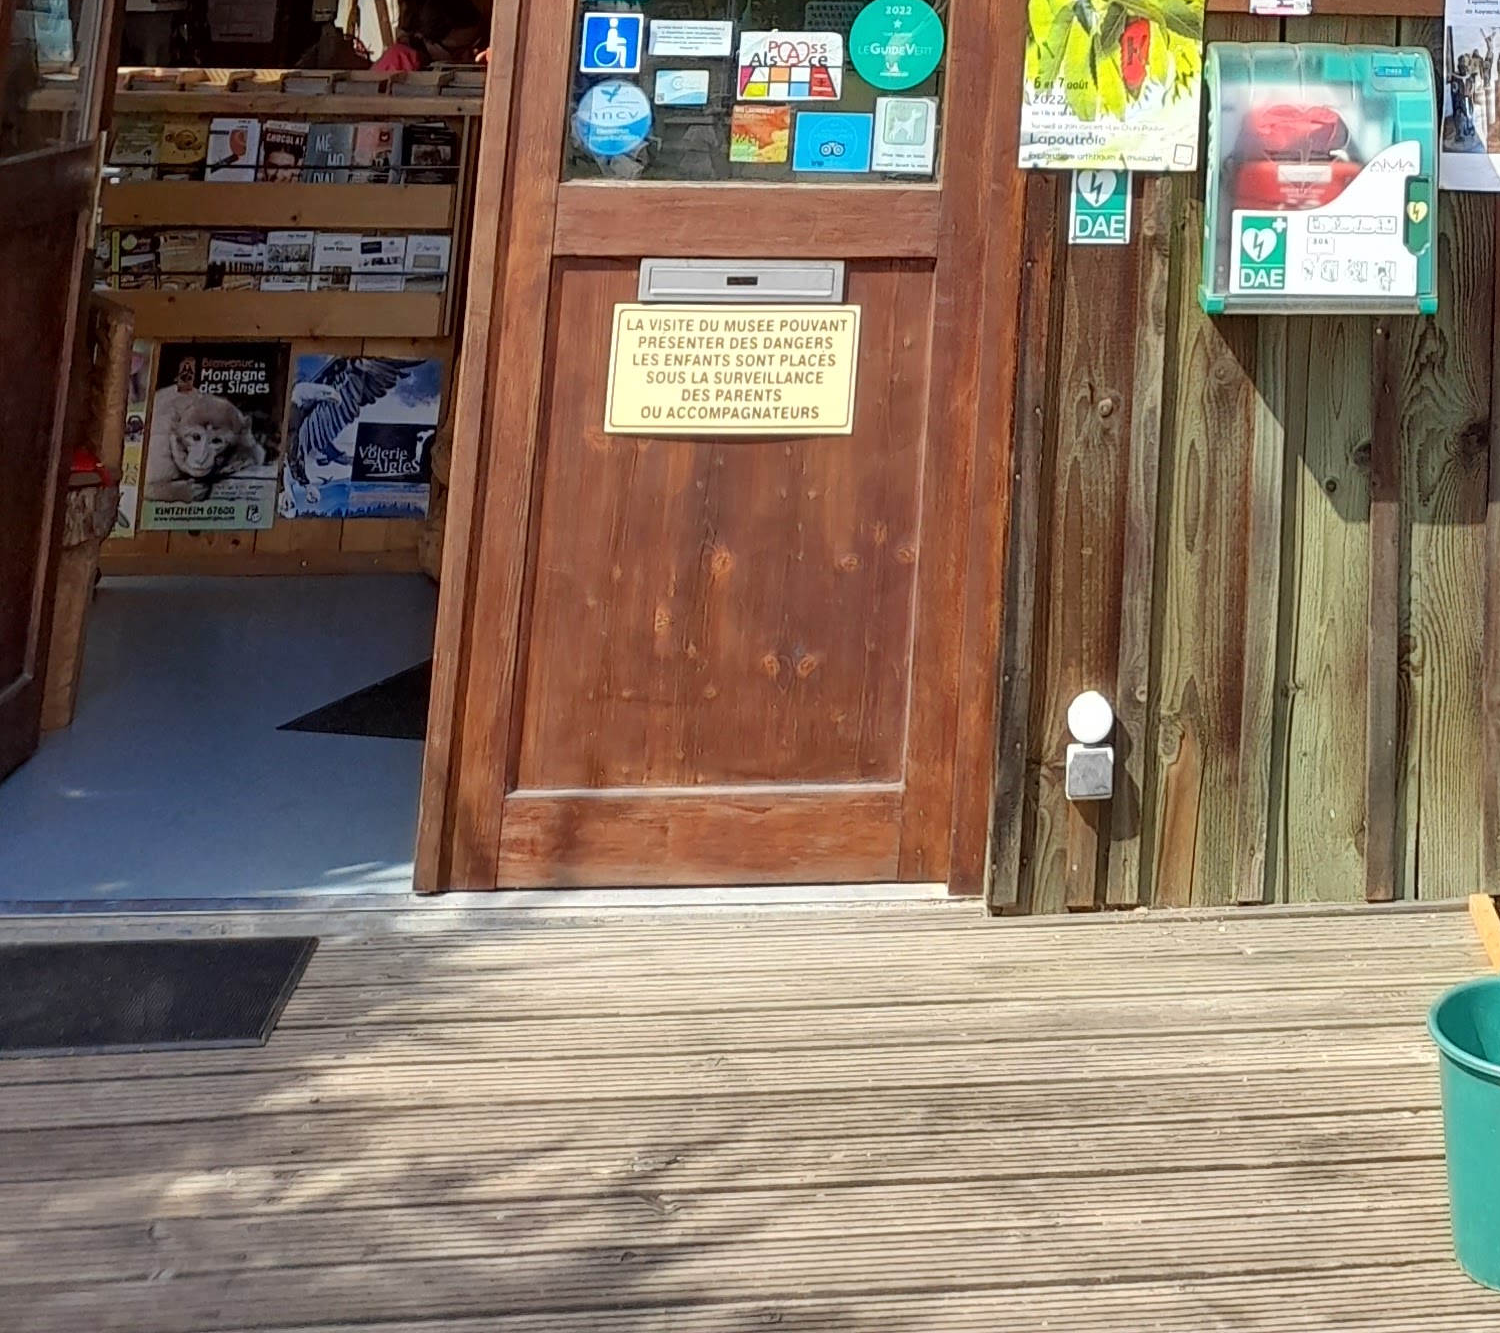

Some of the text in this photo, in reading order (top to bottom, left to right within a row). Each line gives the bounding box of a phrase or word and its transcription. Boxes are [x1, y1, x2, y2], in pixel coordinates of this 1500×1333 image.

[885, 5, 912, 16] 2022
[1034, 77, 1089, 90] 6 et 7 août
[1032, 94, 1065, 106] 2022
[1076, 214, 1125, 238] DAE
[1240, 268, 1284, 288] DAE
[626, 318, 848, 333] LA VISITE DU MUSEE POUVANT
[729, 336, 758, 350] DES
[763, 336, 834, 350] DANGERS
[202, 358, 254, 369] Bienvenue
[632, 353, 659, 367] LES
[664, 354, 731, 367] ENFANTS
[735, 354, 776, 367] SONT
[200, 369, 267, 382] Montagne
[645, 371, 824, 384] SOUS LA SURVEILLANCE
[200, 382, 270, 395] des Singes
[681, 389, 783, 402] DES PARENTS
[640, 406, 820, 420] OU ACCOMPAGNATEURS
[358, 445, 408, 460] Volerie
[371, 457, 421, 474] Aigles
[155, 506, 235, 516] KINTZHEIM 67600
